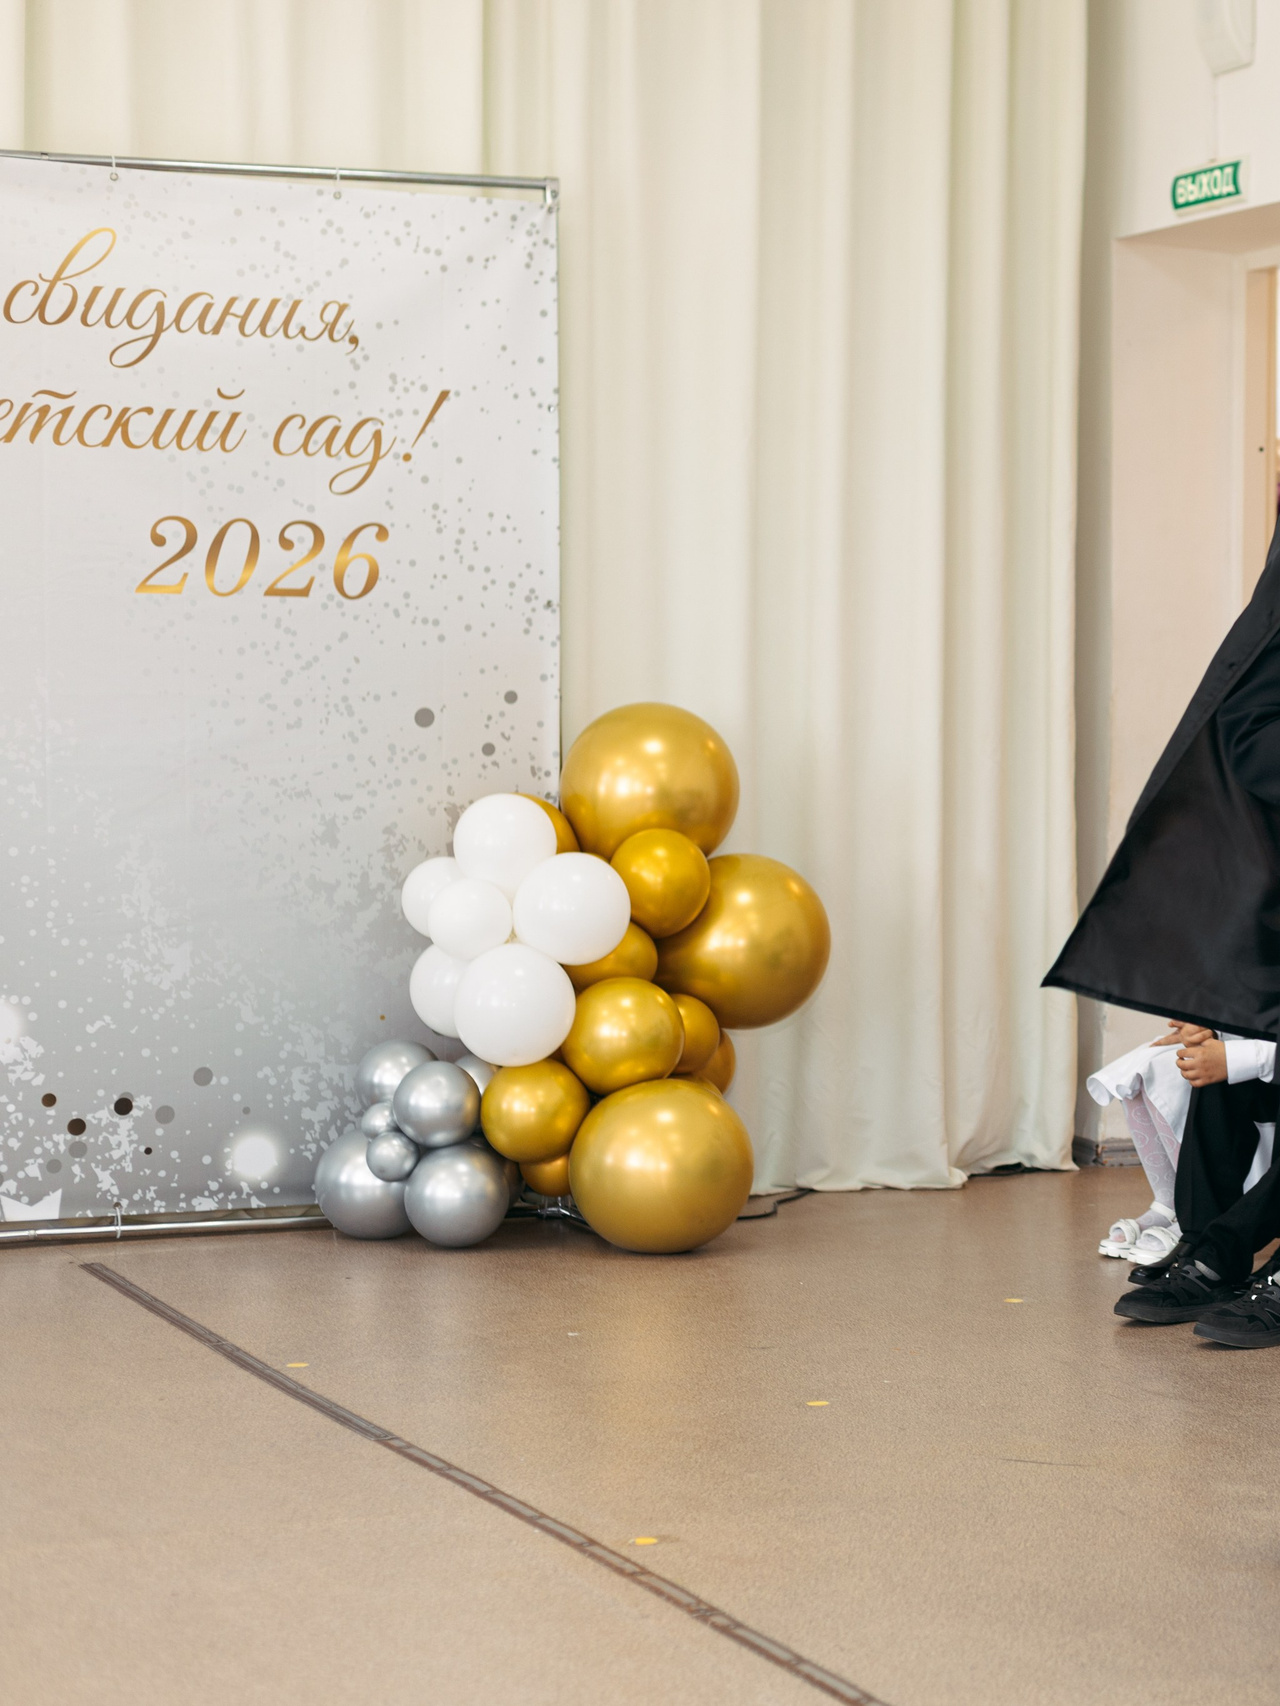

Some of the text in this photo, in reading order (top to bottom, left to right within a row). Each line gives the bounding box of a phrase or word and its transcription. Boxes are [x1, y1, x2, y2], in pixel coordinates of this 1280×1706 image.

[1176, 166, 1236, 205] ВЫХОД
[2, 226, 360, 369] свидания,
[272, 388, 451, 496] сад!
[134, 515, 390, 601] 2026
